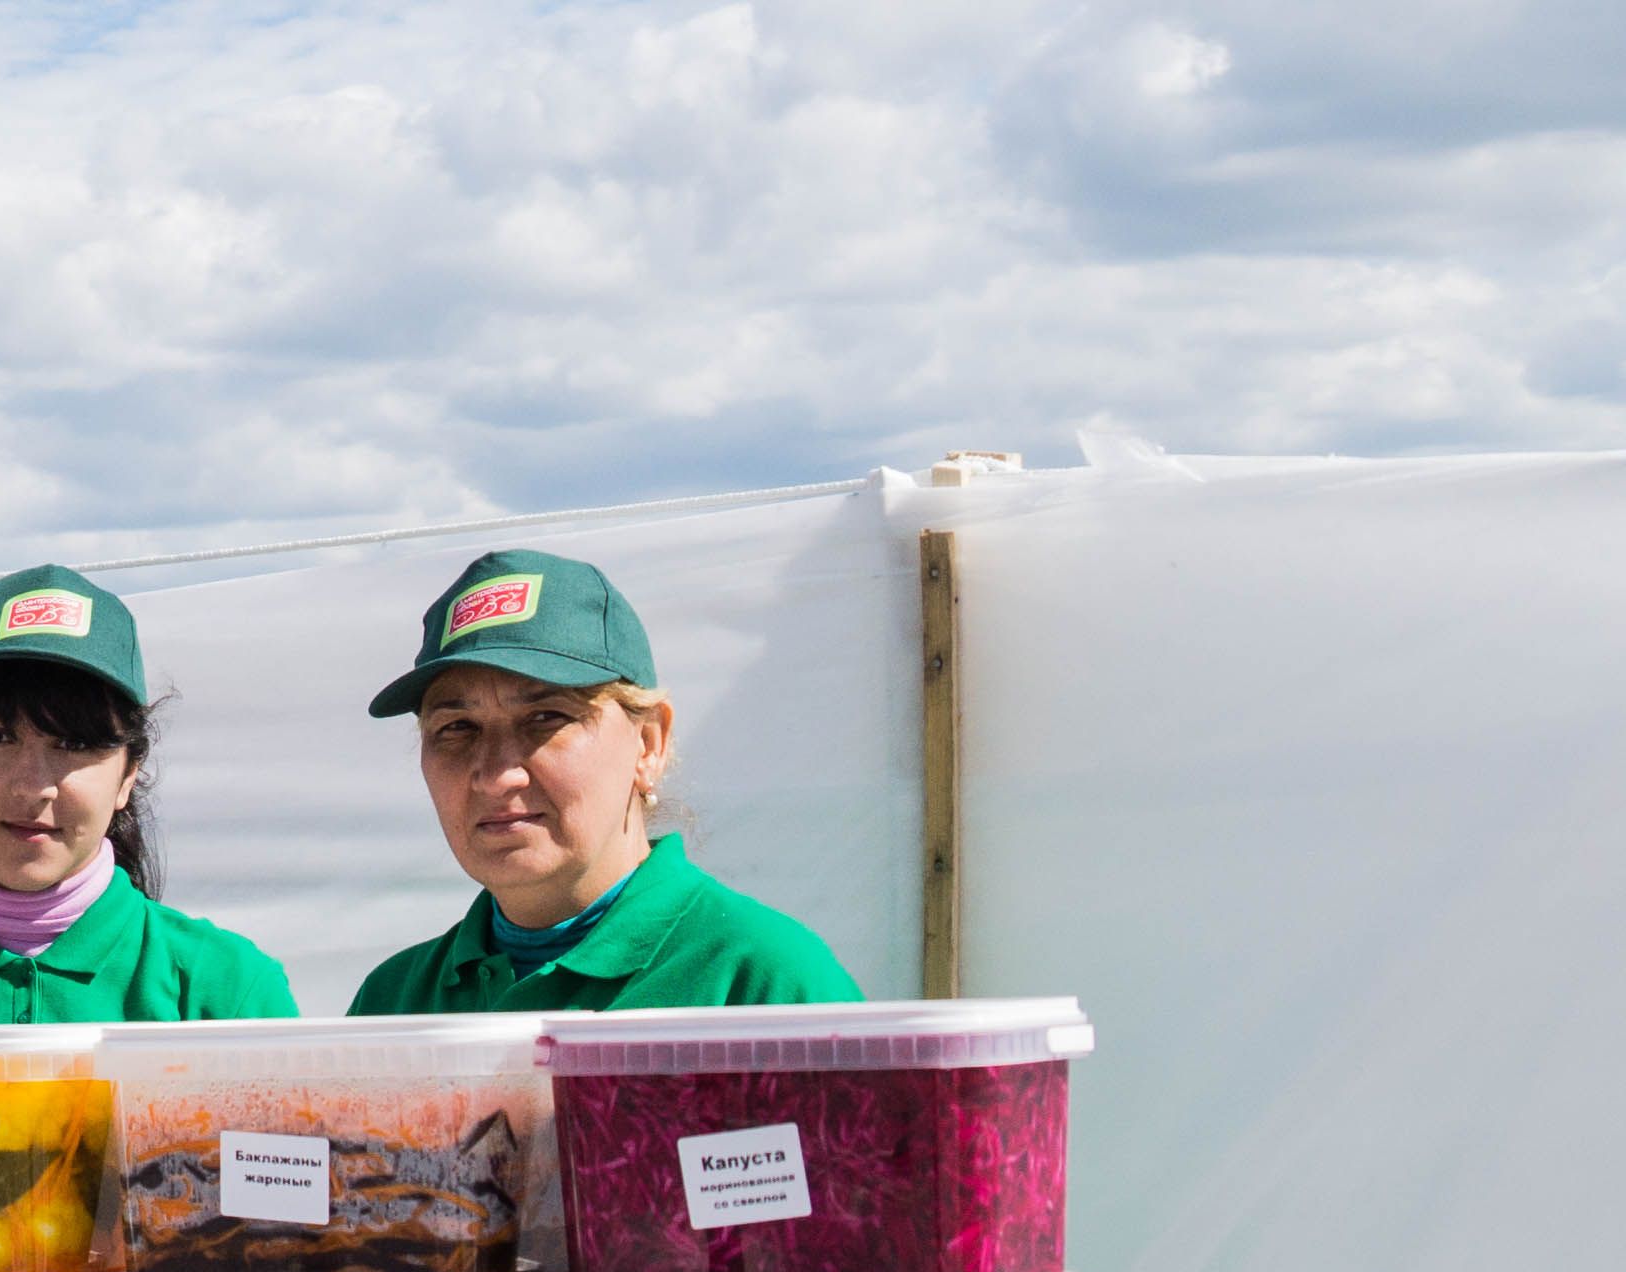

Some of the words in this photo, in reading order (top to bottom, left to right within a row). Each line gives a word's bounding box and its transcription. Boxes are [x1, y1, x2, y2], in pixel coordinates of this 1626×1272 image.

[235, 1150, 323, 1168] Баклажаны
[700, 1150, 787, 1172] Капуста
[244, 1173, 313, 1188] жареные
[699, 1174, 796, 1194] маринованная
[714, 1200, 729, 1210] со
